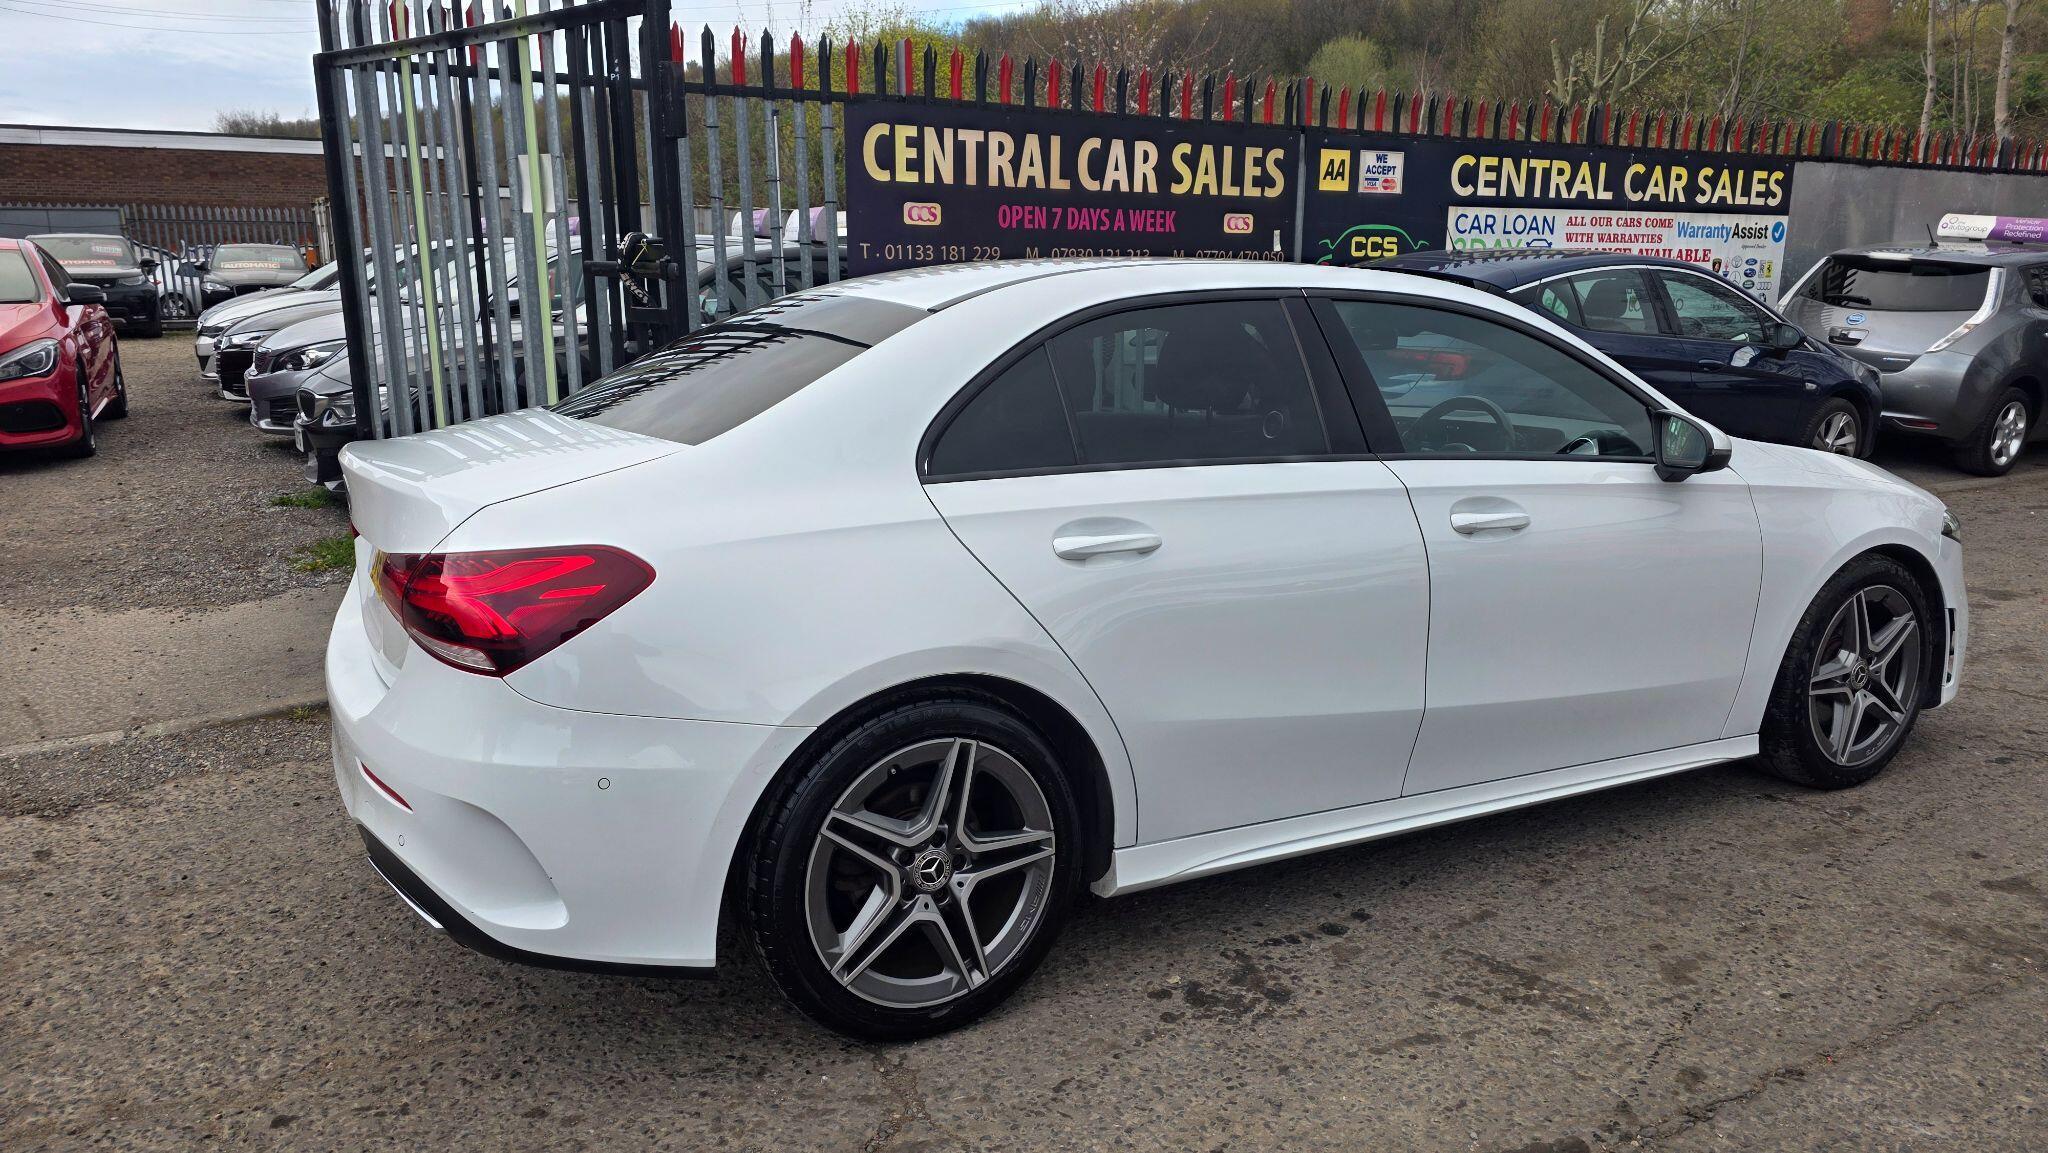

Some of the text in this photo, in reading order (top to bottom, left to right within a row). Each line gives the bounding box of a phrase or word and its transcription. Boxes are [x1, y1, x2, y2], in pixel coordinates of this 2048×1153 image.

[863, 123, 1286, 198] CENTRAL CAR SALES
[1376, 153, 1389, 164] WE
[1323, 158, 1346, 181] AA
[1366, 165, 1397, 176] ACCEPT
[1450, 154, 1784, 207] CENTRAL CAR SALES
[998, 204, 1176, 233] OPEN 7 DAYS A WEEK
[1455, 213, 1556, 236] CAR LOAN
[1566, 216, 1674, 229] ALL OUR CARS COME
[1565, 232, 1663, 244] WITH WARRANTIES
[2004, 229, 2042, 239] Redefined
[885, 244, 934, 260] 01133
[941, 246, 966, 261] 181
[973, 246, 1000, 261] 229
[1350, 236, 1398, 258] CCS
[1638, 247, 1712, 263] AVAILABLE
